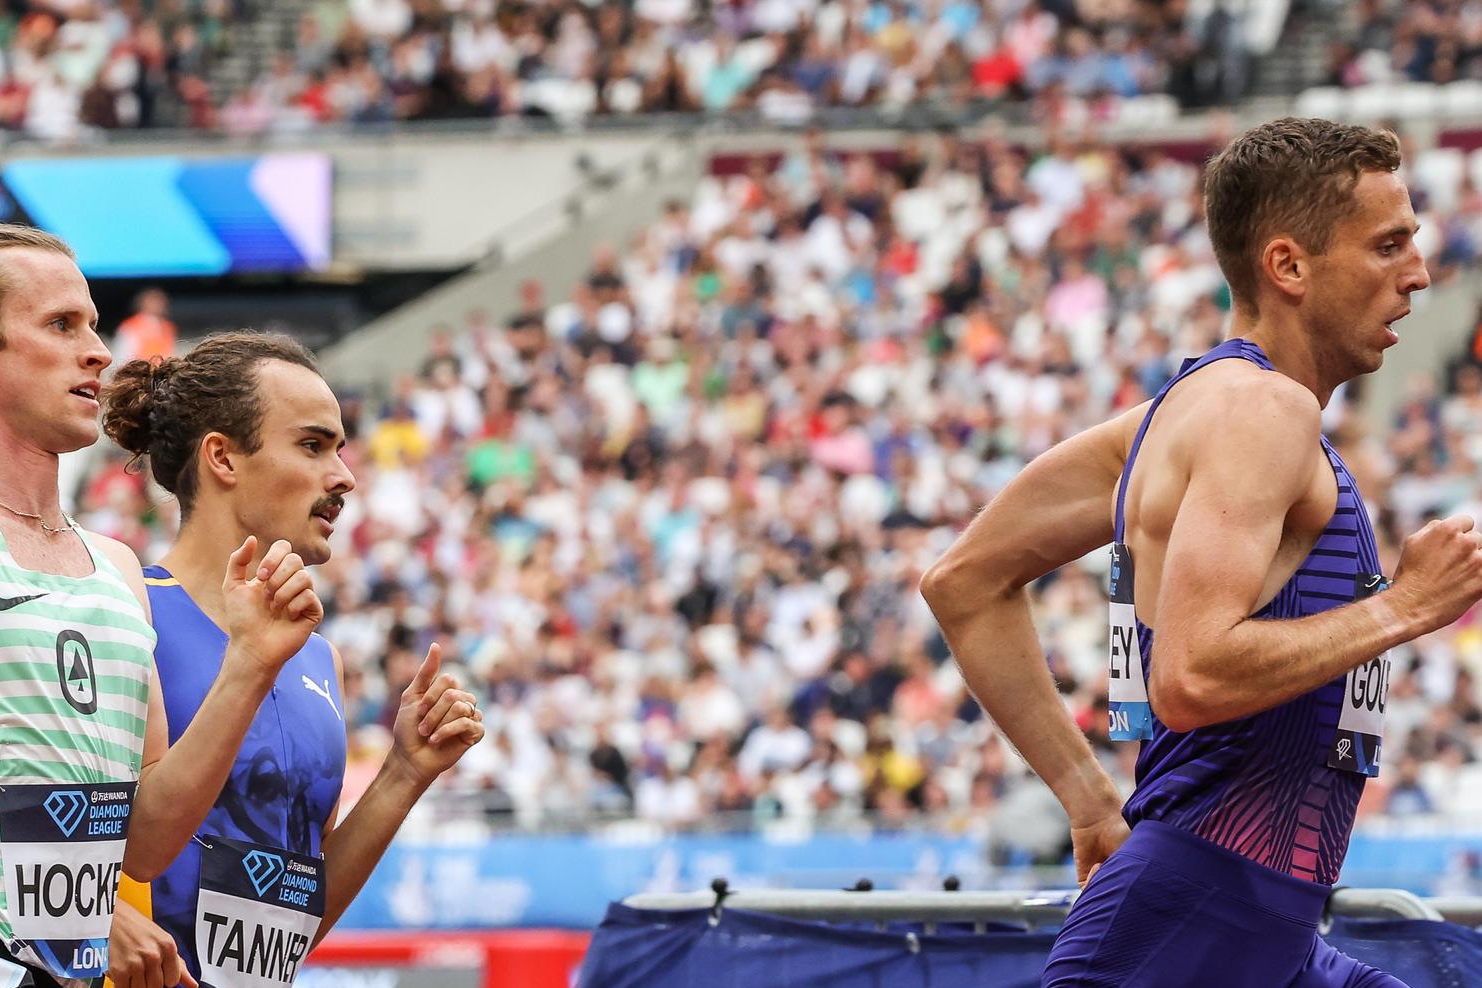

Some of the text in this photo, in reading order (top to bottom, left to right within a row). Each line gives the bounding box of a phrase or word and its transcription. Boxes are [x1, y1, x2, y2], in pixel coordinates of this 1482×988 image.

[89, 804, 130, 819] DIAMOND
[88, 820, 122, 835] LEAGUE
[282, 873, 317, 893] DIAMOND
[278, 888, 309, 907] LEAGUE
[203, 912, 309, 984] TANNER
[72, 947, 108, 970] LON
